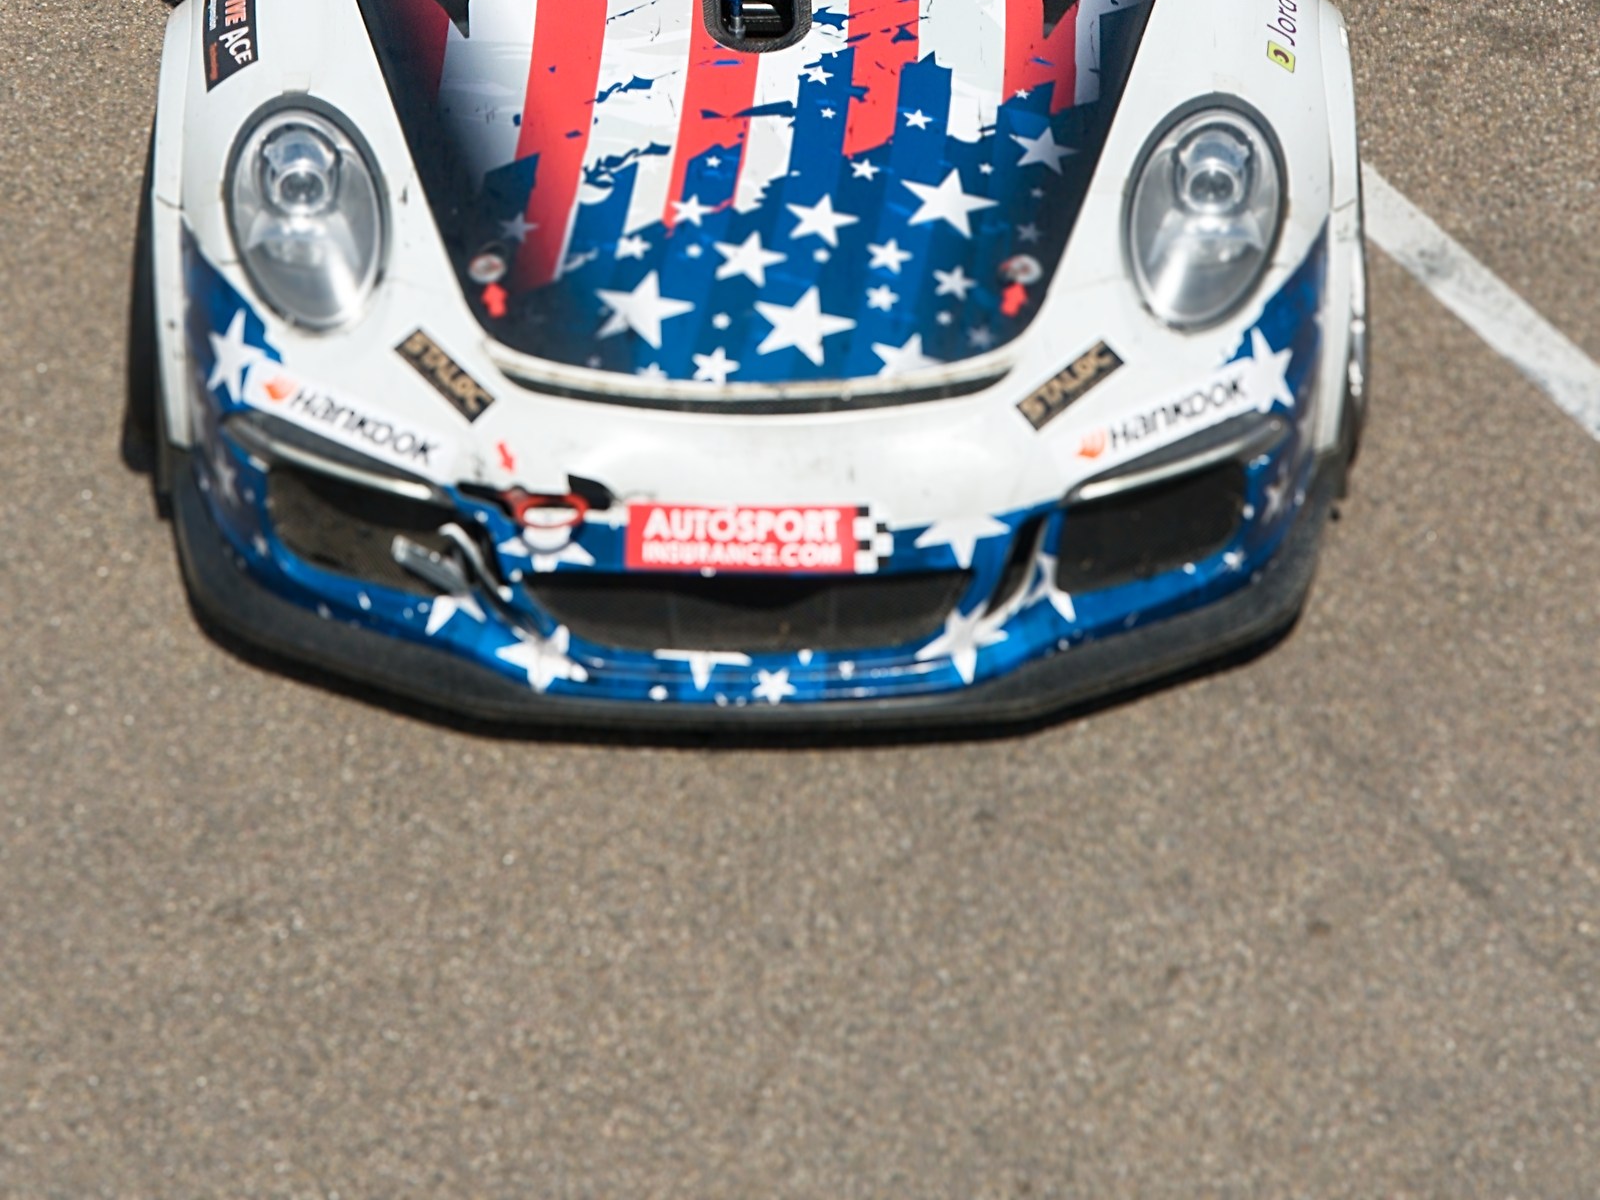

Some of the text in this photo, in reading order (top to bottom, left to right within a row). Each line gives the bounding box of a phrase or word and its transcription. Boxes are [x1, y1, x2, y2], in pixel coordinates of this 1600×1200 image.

[219, 26, 252, 65] ACE
[643, 506, 842, 542] AUTOSPORT
[641, 539, 843, 567] INSURANCE.COM
